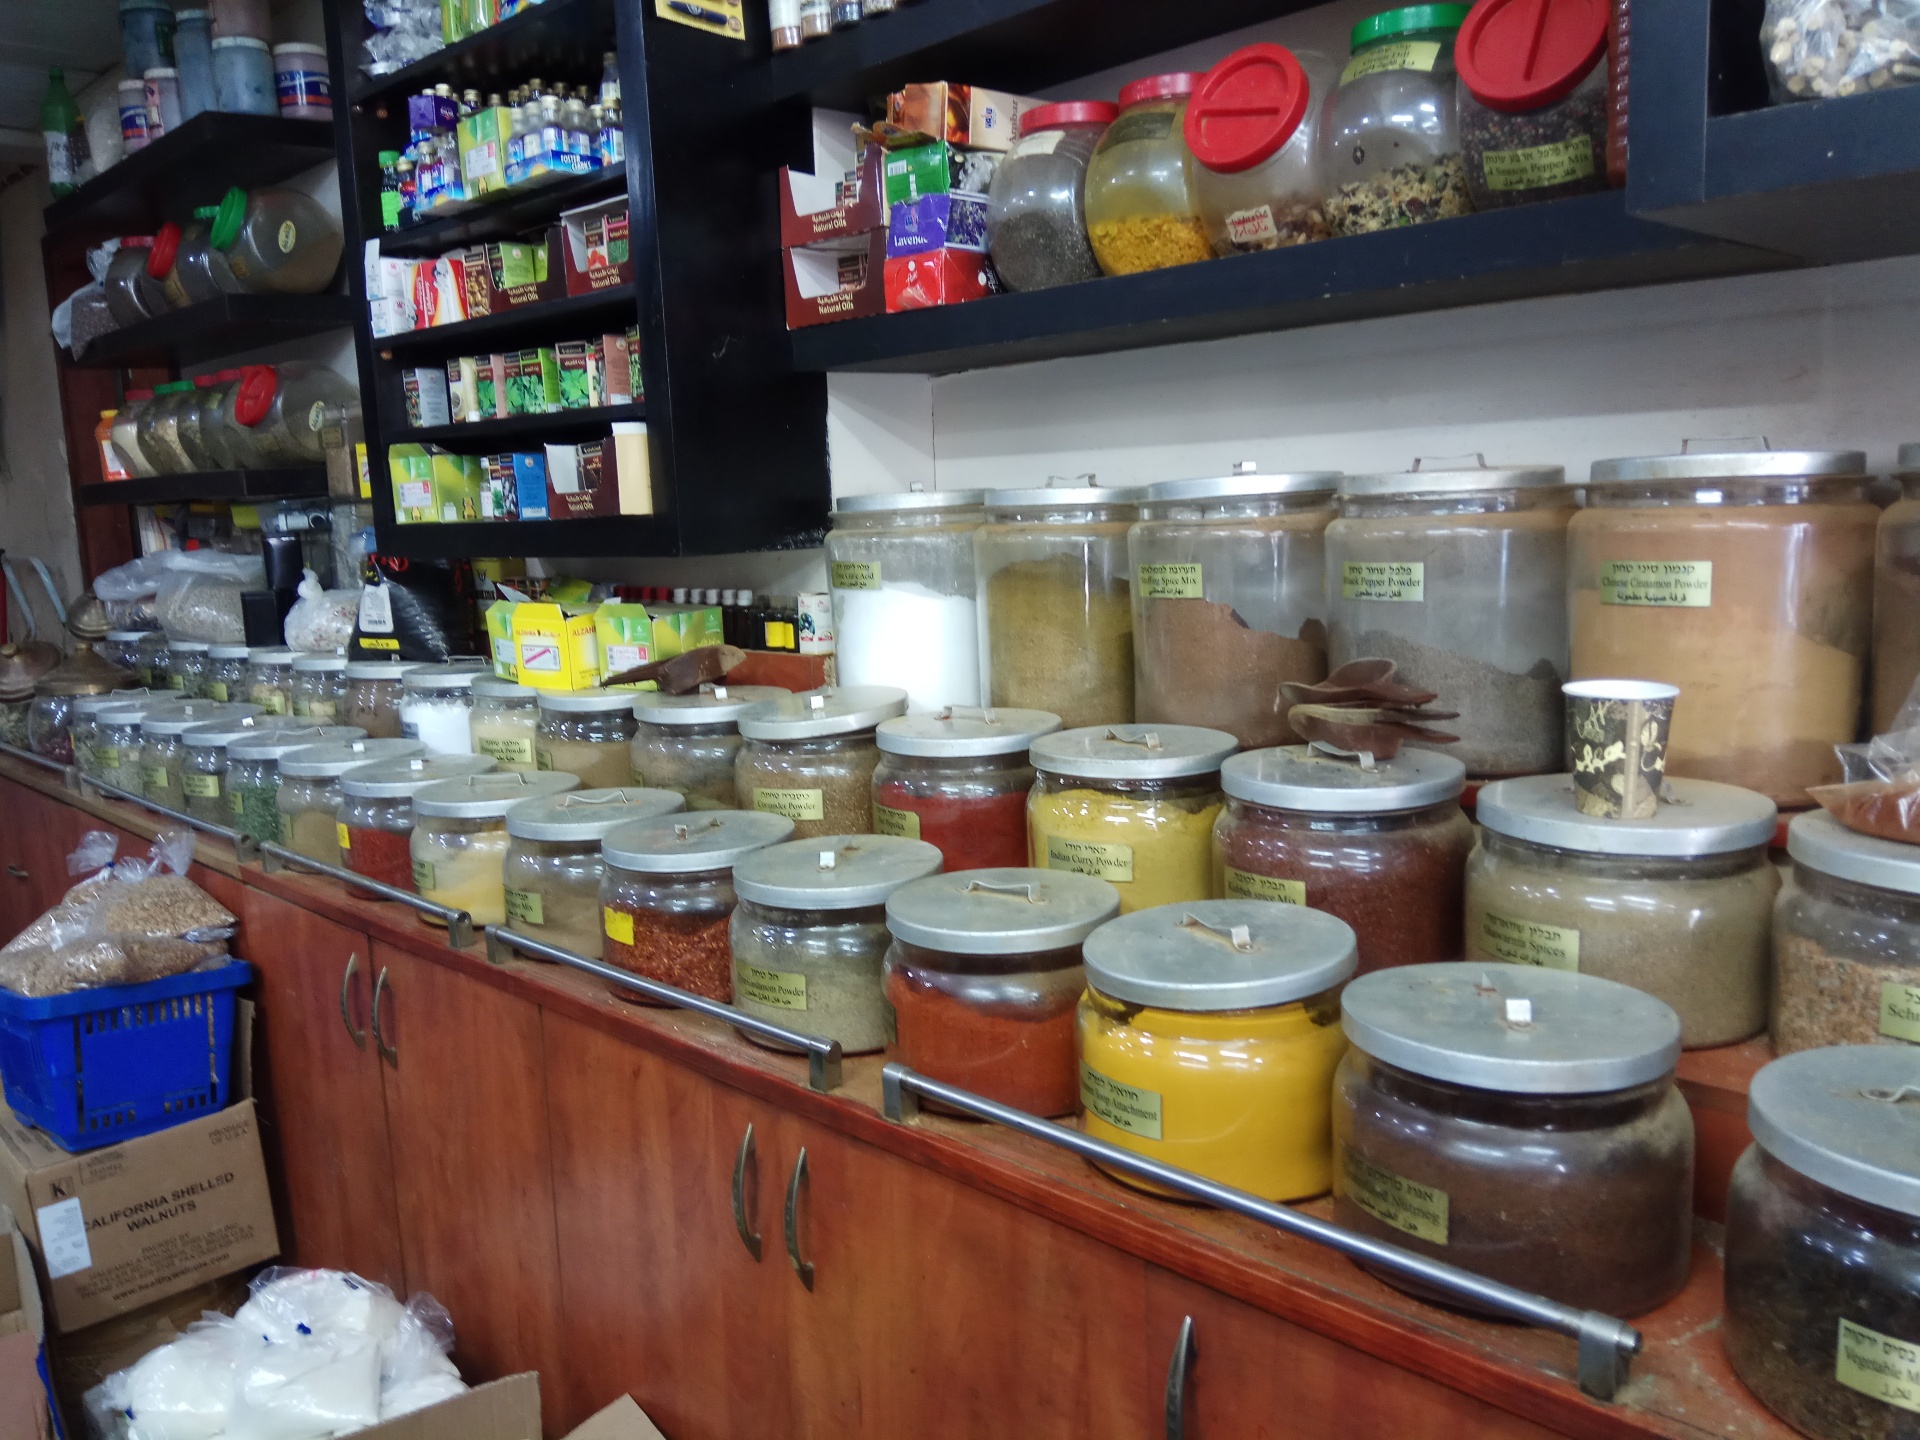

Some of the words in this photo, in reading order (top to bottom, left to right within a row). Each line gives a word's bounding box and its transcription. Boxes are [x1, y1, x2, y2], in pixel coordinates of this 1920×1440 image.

[560, 153, 581, 164] FOSTER
[1530, 161, 1564, 174] Pepper
[1567, 153, 1590, 165] Mix
[813, 220, 834, 233] Natural
[834, 218, 847, 229] Oils
[591, 276, 610, 289] Natural
[610, 274, 621, 285] Oils
[818, 303, 841, 315] Natural
[841, 300, 854, 311] Oils
[1365, 565, 1386, 575] שחור
[1388, 565, 1412, 576] פלפל
[1612, 564, 1634, 574] טחון
[1637, 564, 1659, 574] סיני
[1664, 563, 1695, 575] קנמון
[860, 572, 874, 580] Acid
[1161, 576, 1180, 587] Spice
[1181, 576, 1197, 585] Mix
[1360, 576, 1386, 588] Pepper
[1388, 577, 1421, 587] Powder
[1630, 578, 1672, 589] Cinnamon
[1674, 578, 1709, 589] Powder
[788, 802, 815, 811] Powder
[1071, 854, 1093, 867] Curry
[1095, 856, 1127, 868] Powder
[1277, 894, 1297, 905] Mix
[1529, 940, 1566, 959] Spices
[777, 985, 804, 997] Powder
[1112, 1097, 1158, 1121] Attachment
[171, 1171, 235, 1202] SHELLED
[126, 1199, 197, 1233] WALNUTS
[1844, 1344, 1903, 1380] Vegetable
